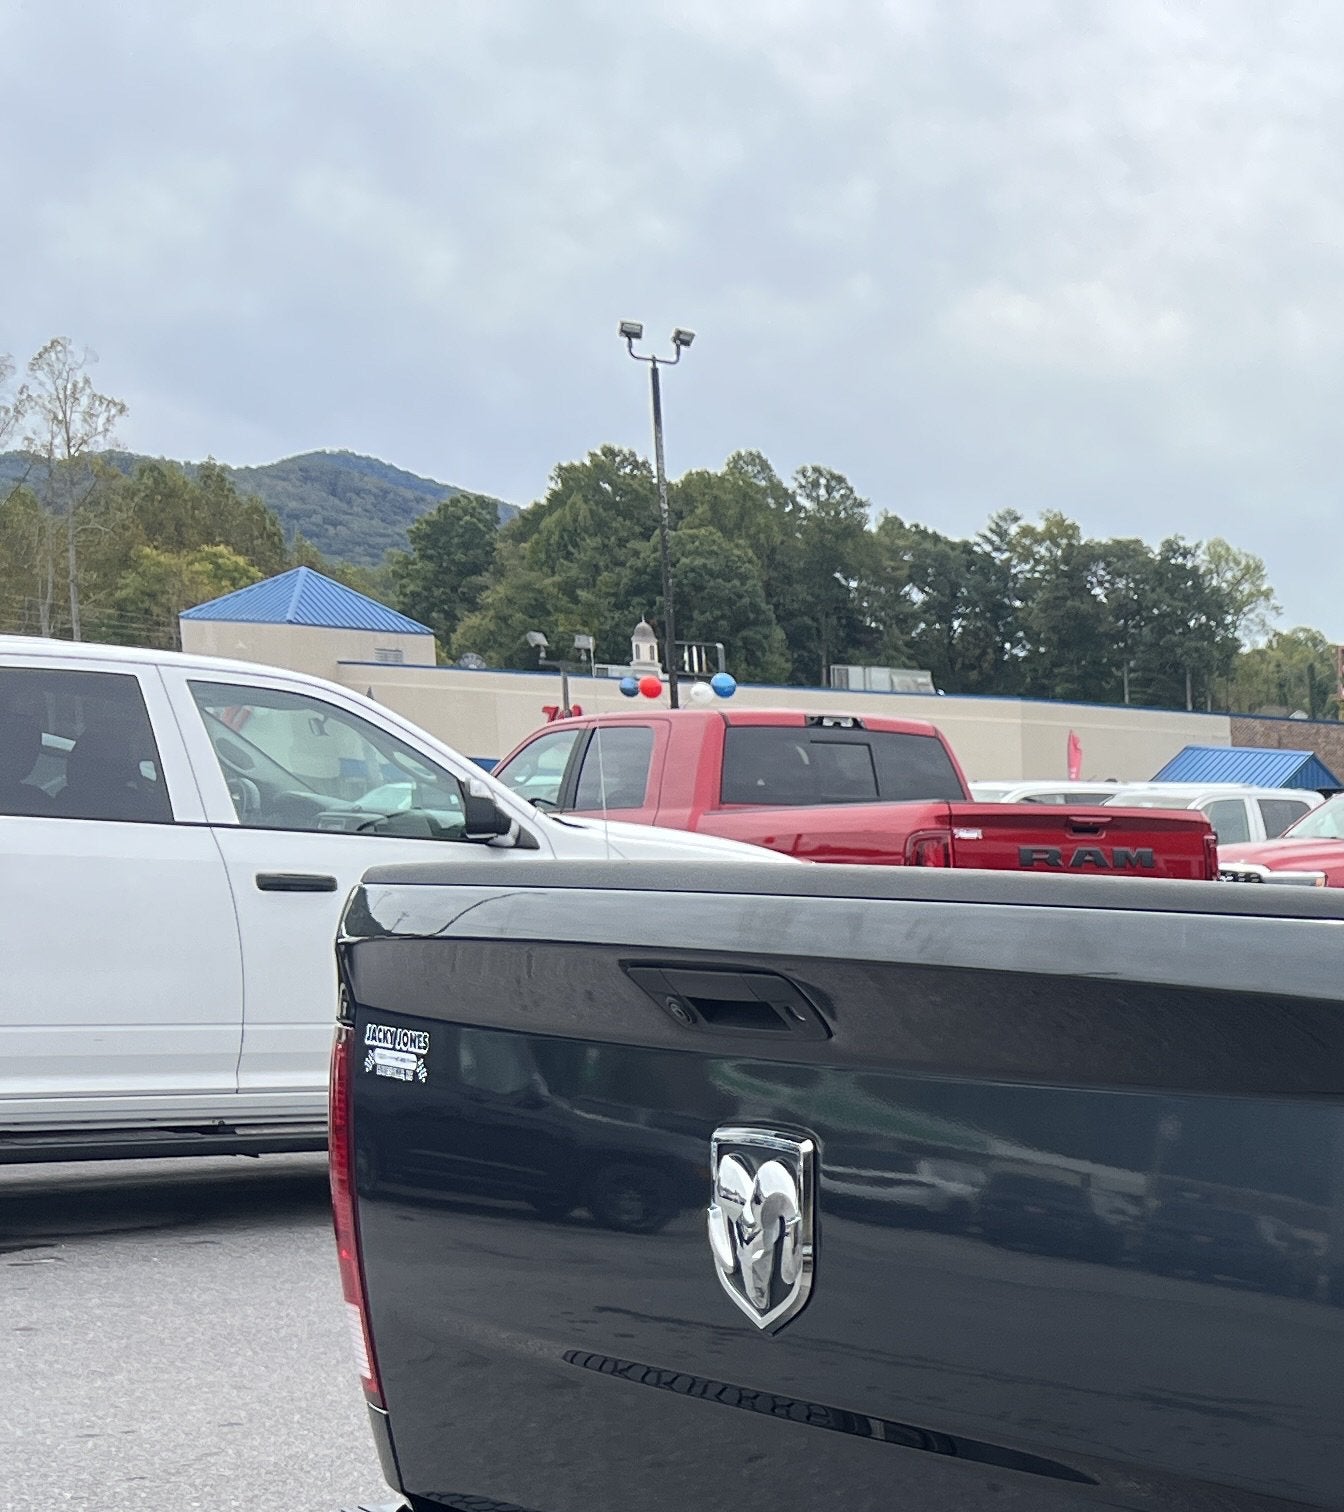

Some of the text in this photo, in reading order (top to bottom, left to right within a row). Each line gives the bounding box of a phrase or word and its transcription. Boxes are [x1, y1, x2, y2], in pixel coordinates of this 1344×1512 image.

[1018, 845, 1155, 868] RAM
[365, 1023, 429, 1055] JACKY JONES
